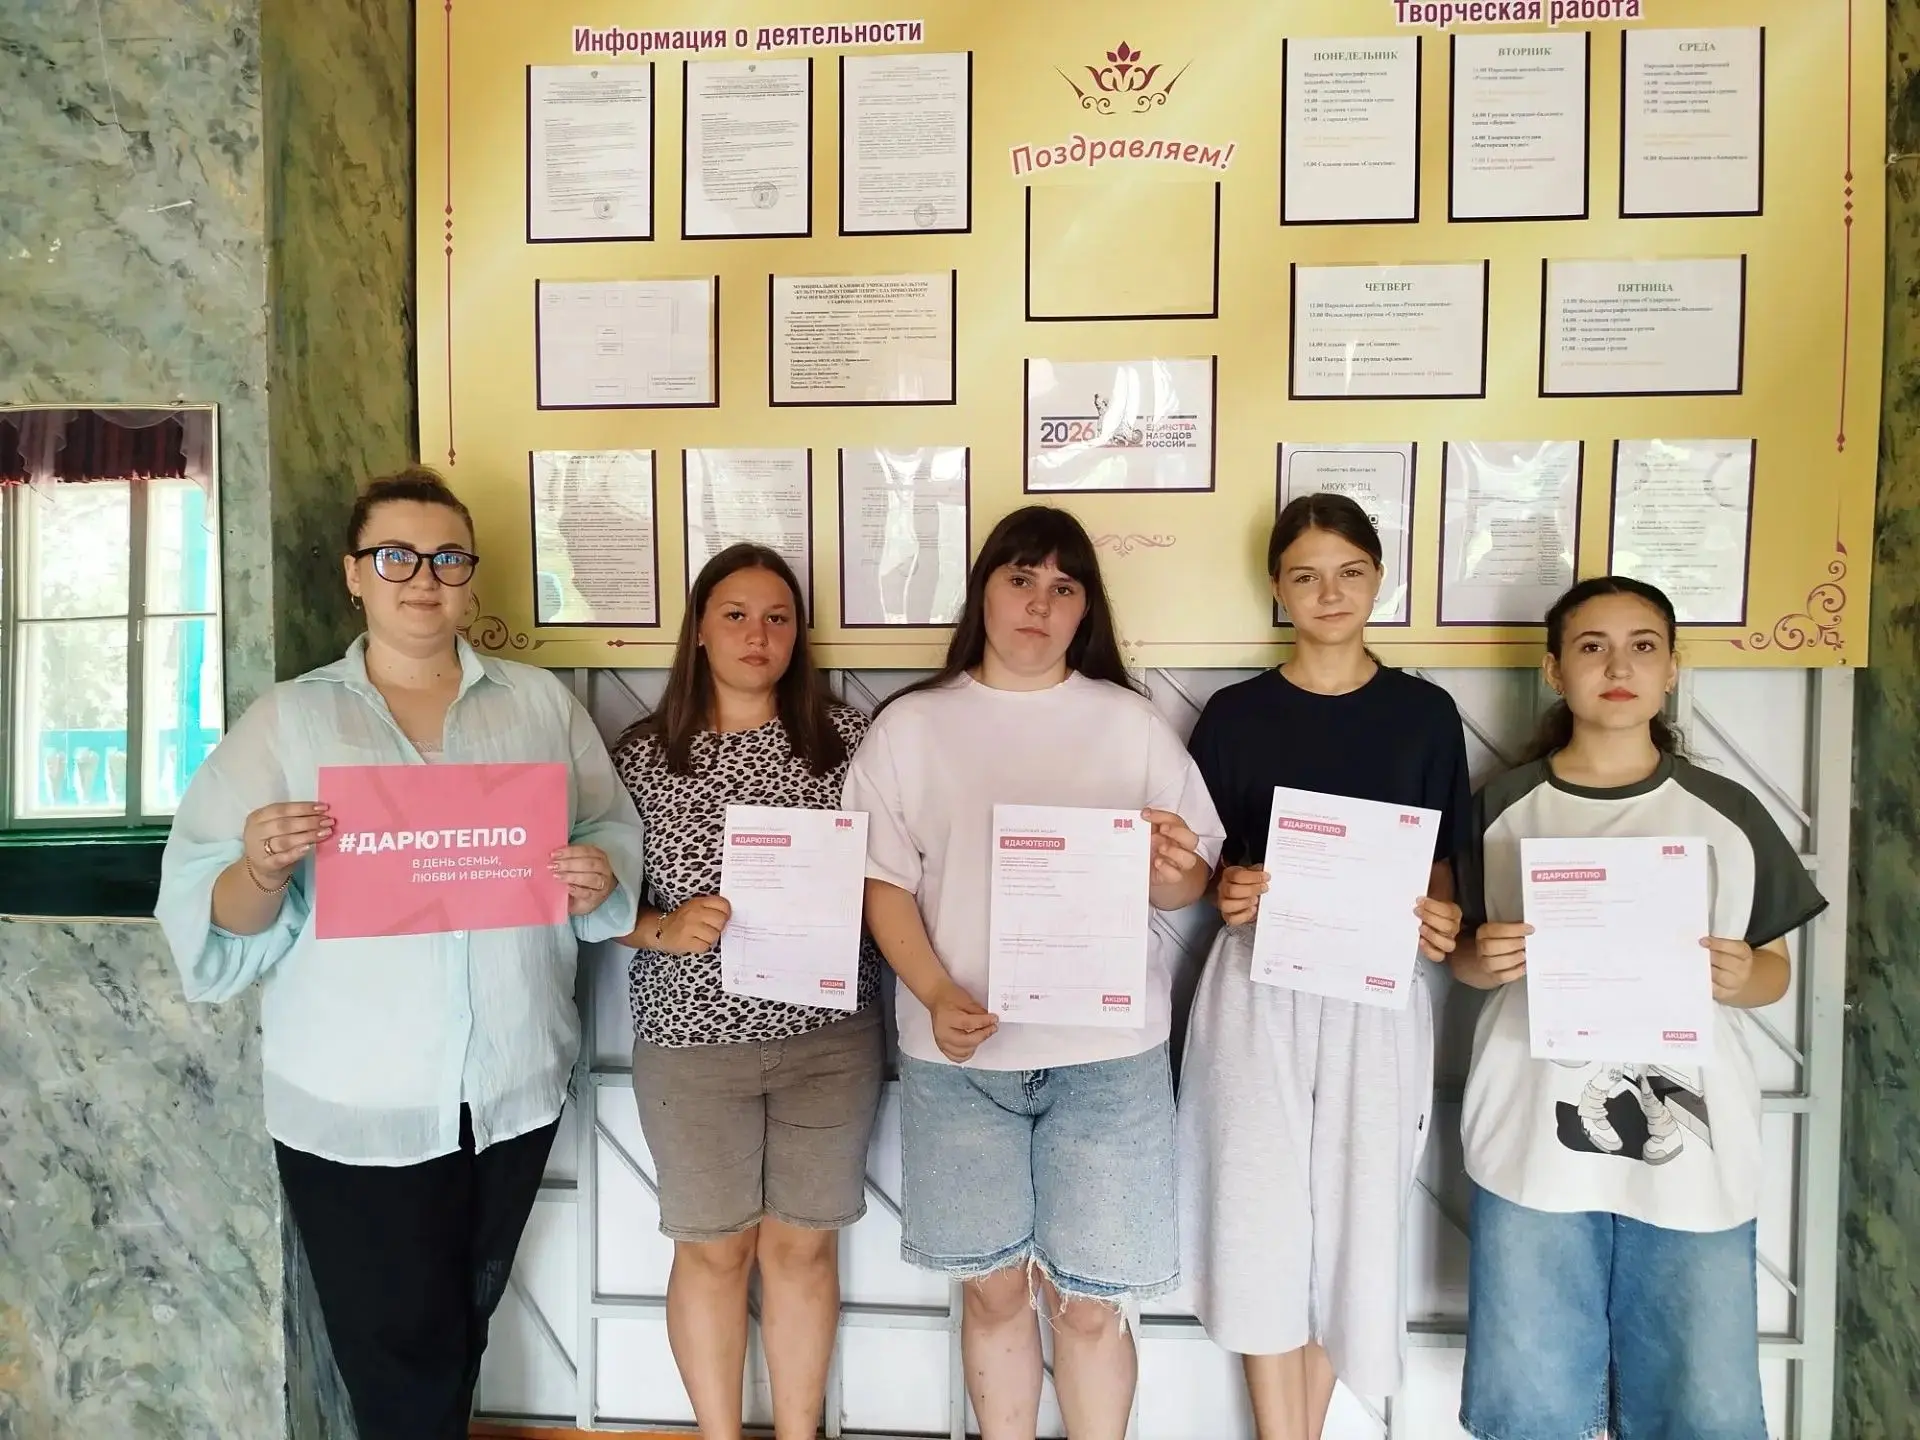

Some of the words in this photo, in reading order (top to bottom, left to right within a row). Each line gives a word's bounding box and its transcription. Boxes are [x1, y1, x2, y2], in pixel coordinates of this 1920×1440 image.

[1394, 0, 1541, 27] Творческая
[1551, 0, 1640, 24] работа
[574, 28, 727, 56] Информация
[735, 29, 748, 48] о
[756, 22, 922, 50] деятельности
[1498, 47, 1552, 57] ВТОРНИК
[1678, 42, 1716, 52] СРЕДА
[1313, 51, 1399, 61] ПОНЕДЕЛЬНИК
[1012, 135, 1236, 175] Поздравляем!
[1365, 282, 1414, 292] ЧЕТВЕРГ
[1617, 283, 1673, 292] ПЯТНИЦА
[1040, 422, 1095, 443] 2026
[1146, 432, 1192, 440] НАРОДОВ
[1321, 482, 1346, 491] МКУК
[1283, 820, 1342, 834] #ДАРЮТЕПЛО
[338, 827, 527, 855] #ДАРЮТЕПЛО
[735, 837, 787, 845] #ДАРЮТЕПЛО
[1004, 839, 1061, 848] #ДАРЮТЕПЛО
[412, 859, 421, 869] В
[423, 858, 455, 869] ДЕНЬ
[458, 856, 502, 867] СЕМЬИ,
[412, 871, 456, 883] ЛЮБВИ
[459, 872, 468, 881] И
[470, 868, 532, 880] ВЕРНОСТИ
[1536, 871, 1601, 880] #ДАРЮТЕПЛО
